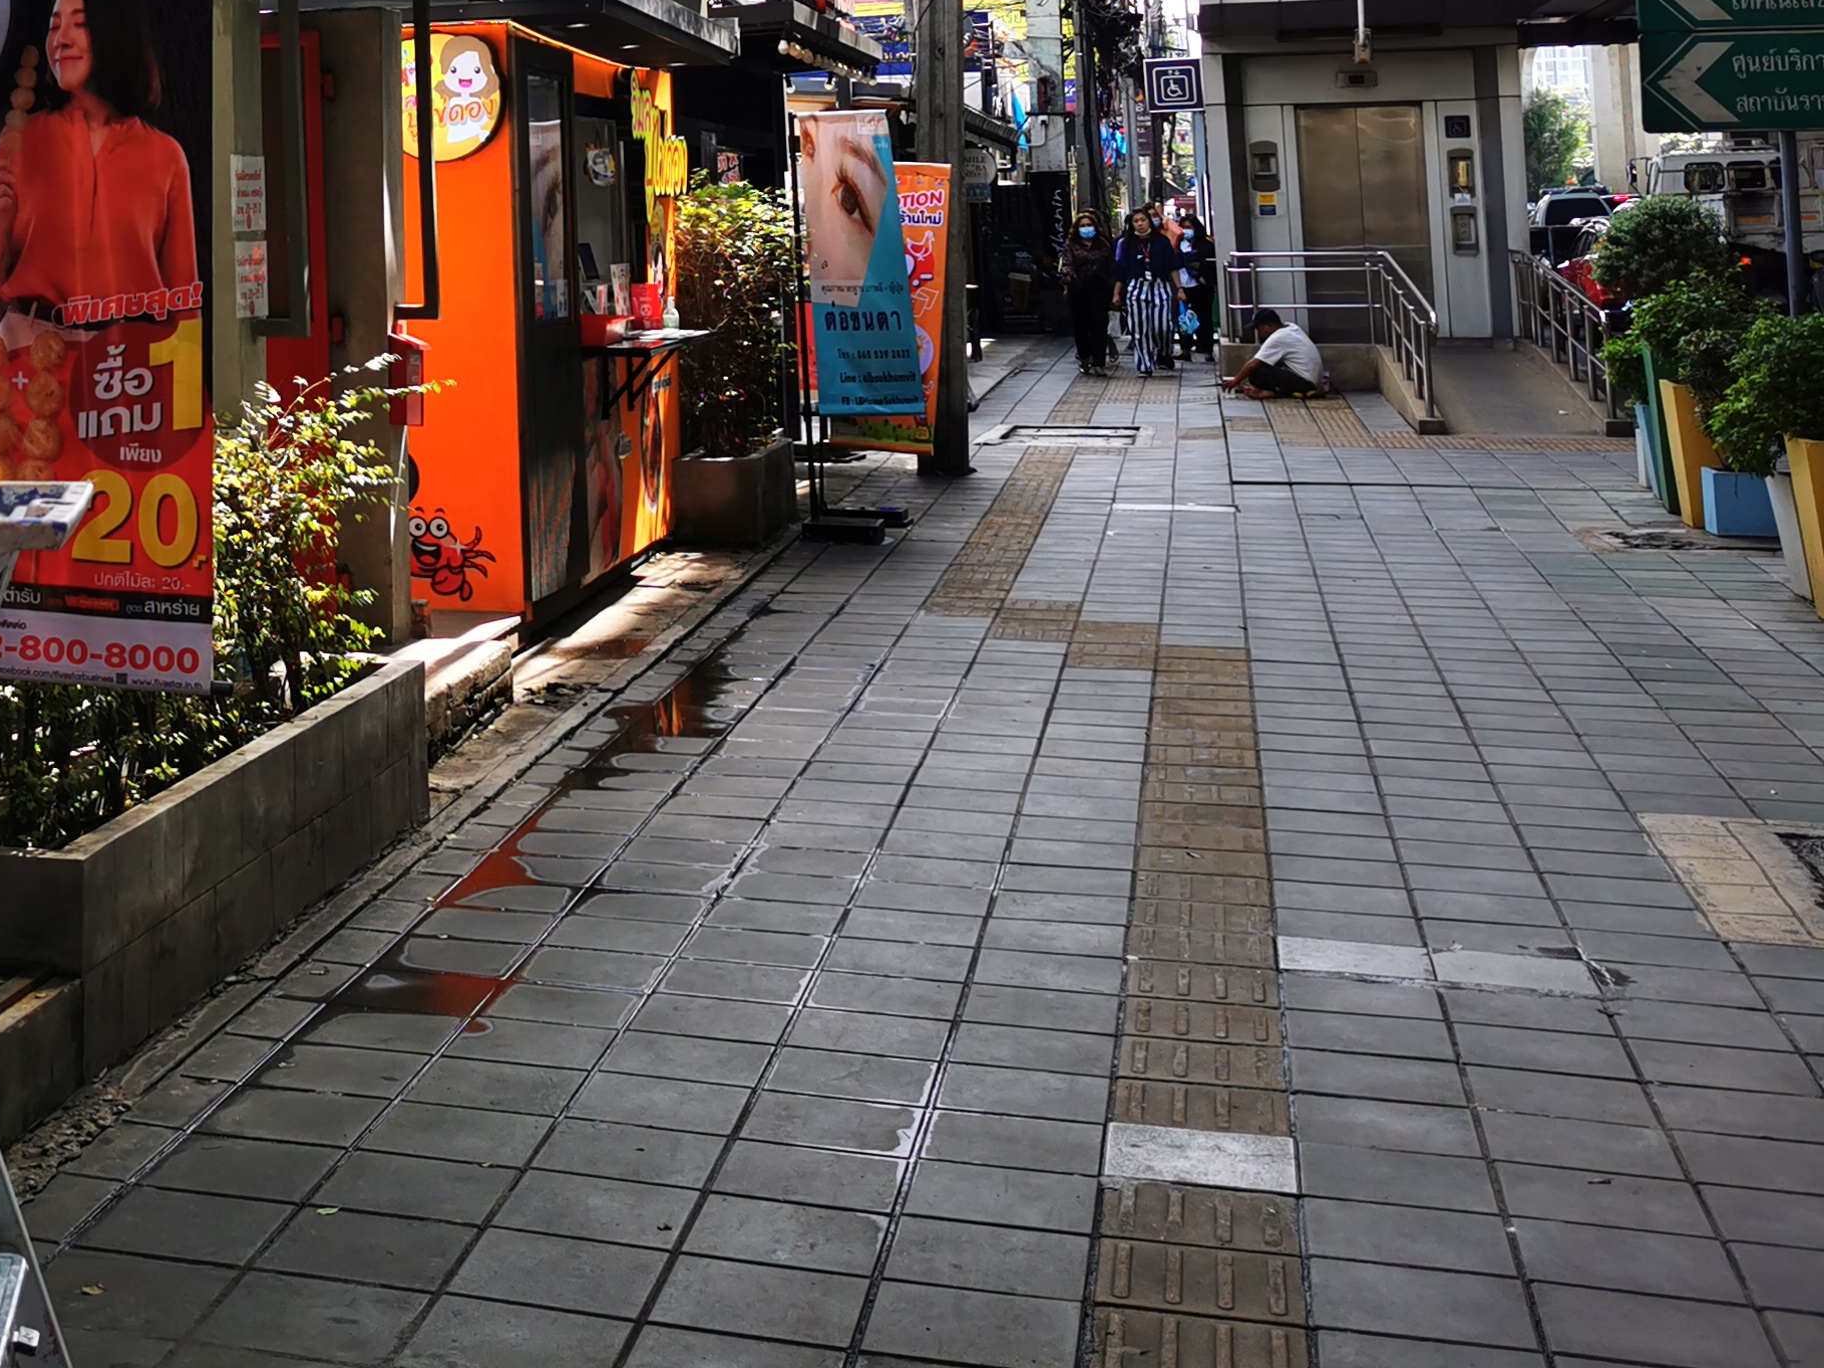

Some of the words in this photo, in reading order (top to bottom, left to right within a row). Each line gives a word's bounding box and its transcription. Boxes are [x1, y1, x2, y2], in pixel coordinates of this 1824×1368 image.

[1735, 86, 1824, 114] สถาบันรา
[60, 282, 204, 327] พิเศษสุด!
[824, 300, 903, 331] ต่อขนตา
[93, 344, 154, 401] ซื้อ
[148, 318, 204, 432] 1
[78, 401, 162, 440] แถม
[119, 443, 163, 464] เพียง
[94, 570, 156, 590] ปกติไม้ละ
[143, 598, 201, 617] สาหร่าย
